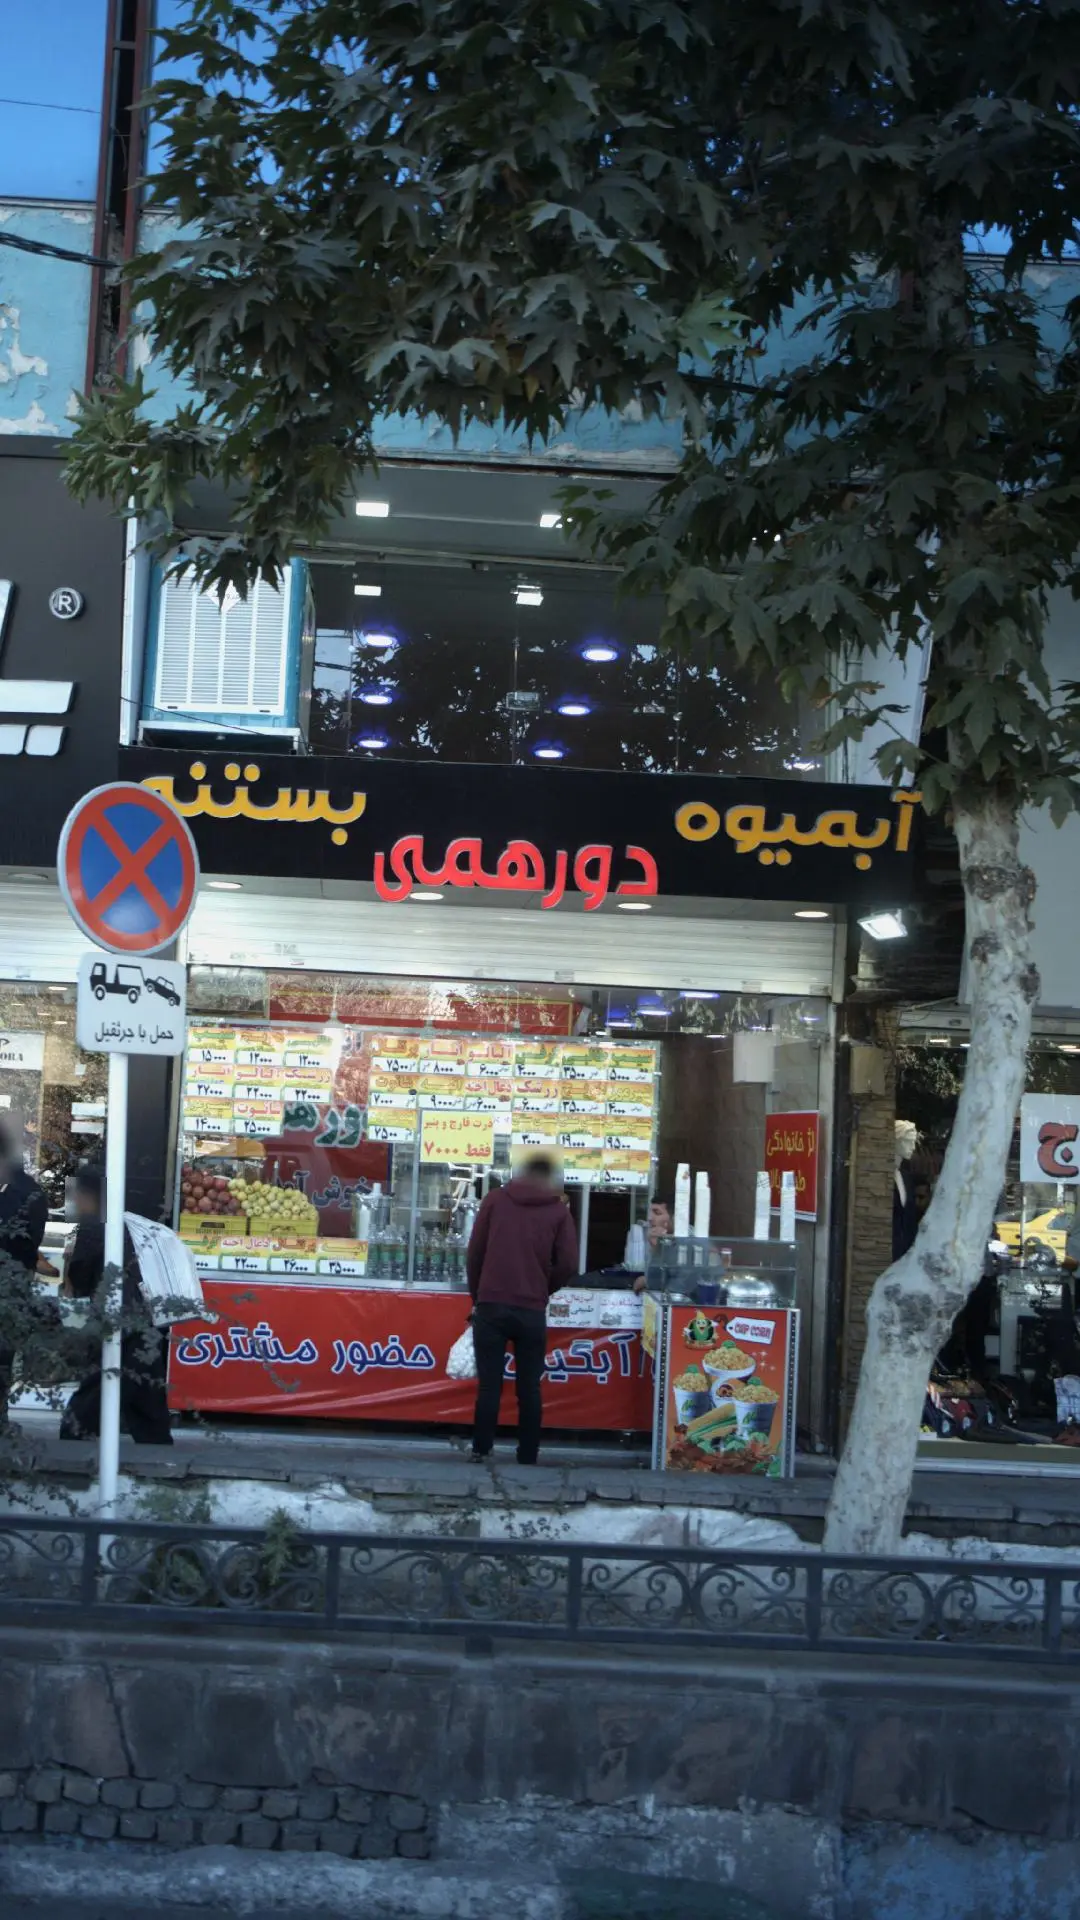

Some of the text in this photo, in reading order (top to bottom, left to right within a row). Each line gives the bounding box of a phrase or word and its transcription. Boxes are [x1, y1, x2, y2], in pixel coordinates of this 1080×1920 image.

[675, 790, 922, 870] آبمیوه
[374, 834, 660, 911] دورهمی
[95, 1021, 174, 1045] حمل با جرثقیل
[202, 1050, 227, 1062] ۱۵۰۰۰
[433, 1062, 453, 1072] ۸۰۰۰
[424, 1141, 492, 1157] فقط ۷۰۰۰
[175, 1321, 319, 1369] مشتری
[331, 1334, 436, 1376] حضور
